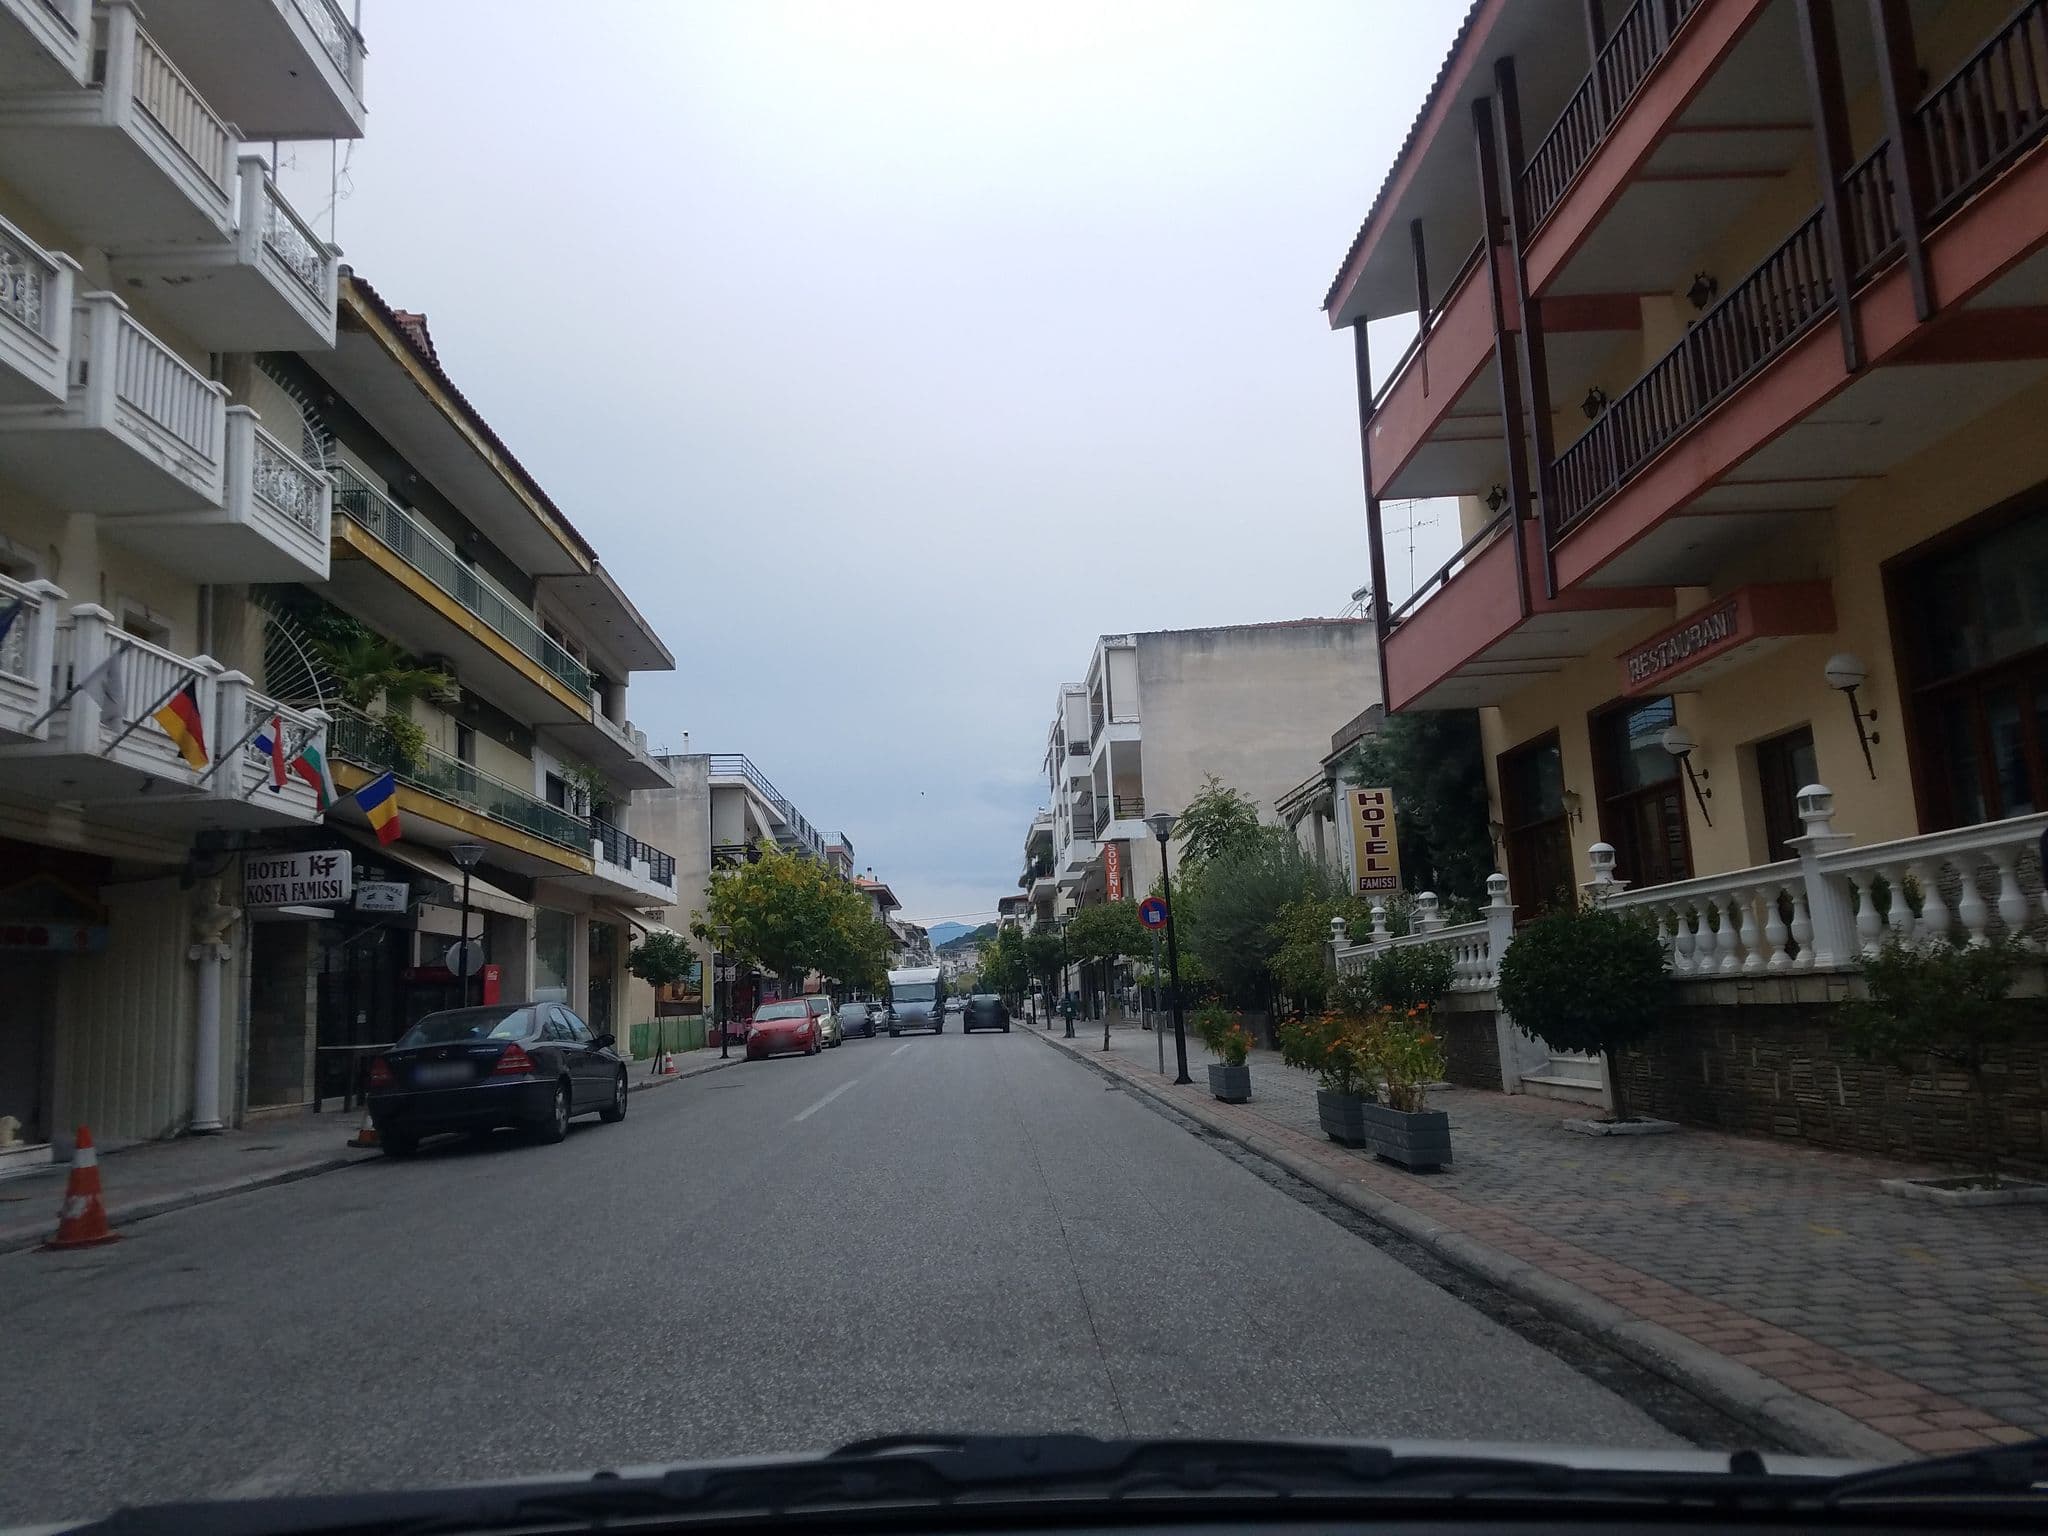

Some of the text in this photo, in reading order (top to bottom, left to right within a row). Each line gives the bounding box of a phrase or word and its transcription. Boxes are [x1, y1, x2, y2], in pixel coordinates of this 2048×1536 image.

[1358, 792, 1390, 872] HOTEL
[248, 860, 300, 880] HOTEL
[247, 879, 343, 904] KOSTA FAMISSI
[1360, 877, 1396, 889] FAMISSI
